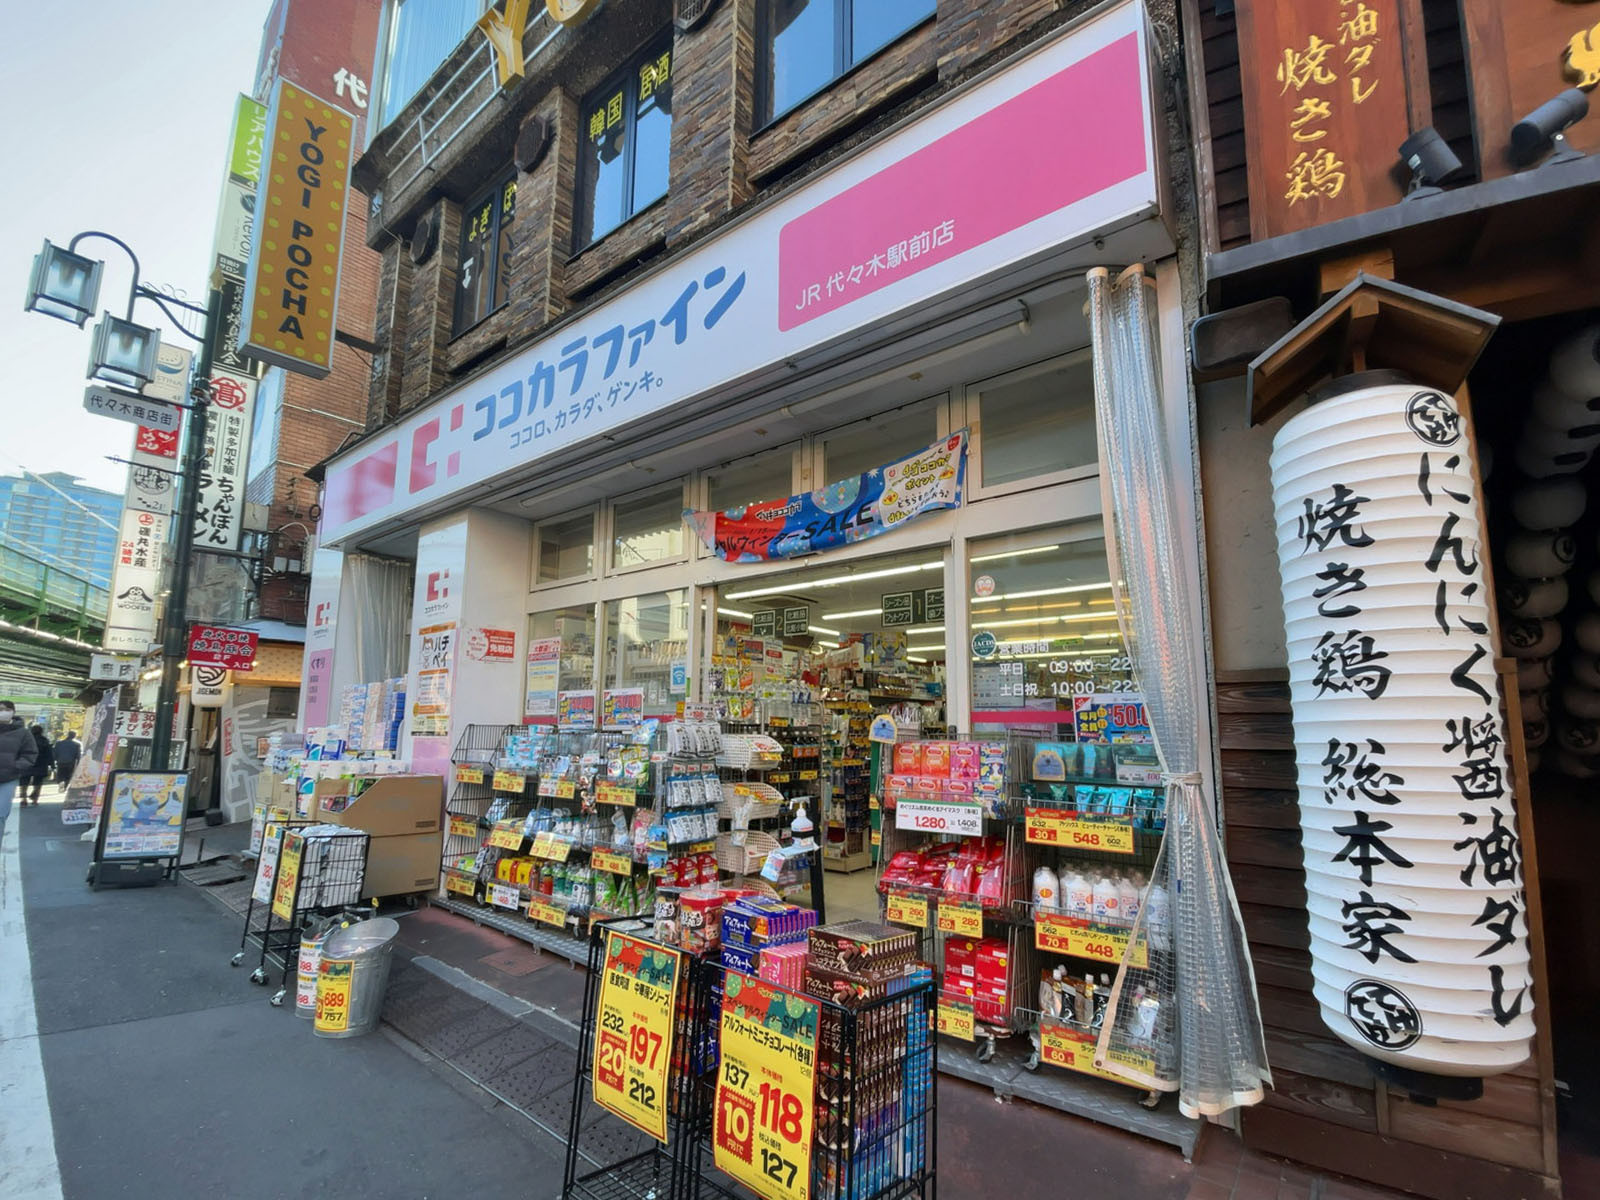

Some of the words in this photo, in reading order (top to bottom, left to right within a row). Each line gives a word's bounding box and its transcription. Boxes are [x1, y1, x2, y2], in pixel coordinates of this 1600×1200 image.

[1337, 0, 1381, 104] 油ダレ
[589, 91, 623, 140] 韓国
[1276, 34, 1346, 208] 焼き鶏
[297, 118, 326, 209] YOGI
[278, 219, 313, 340] POCHA
[795, 283, 821, 310] JR
[825, 219, 955, 297] 代々木駅前店
[473, 265, 746, 441] ココカラファイン
[90, 395, 172, 426] 代々木商店街
[510, 369, 664, 449] ココロ、カラダ、ゲンキ。
[209, 477, 235, 545] ちゃんぽん
[1297, 483, 1392, 700] 焼き鶏
[434, 635, 449, 652] ハチ
[999, 663, 1023, 676] 平日
[1000, 683, 1038, 697] 土日祝
[1417, 451, 1529, 1027] にんにく醤油ダレ
[1035, 830, 1048, 840] 30
[1073, 832, 1100, 846] 548
[1321, 737, 1419, 965] 総本家
[724, 915, 750, 931] アルフォート
[962, 917, 979, 927] 280
[811, 937, 838, 951] アルフォート
[1045, 937, 1059, 947] 70
[1085, 943, 1114, 958] 448
[324, 991, 345, 1007] 689
[324, 1012, 343, 1021] 757
[602, 1012, 624, 1034] 232
[953, 1018, 970, 1028] 703
[601, 1047, 624, 1076] 20
[630, 1024, 662, 1070] 197
[1051, 1051, 1065, 1061] 60
[724, 1062, 750, 1085] 137
[629, 1078, 655, 1109] 212
[723, 1102, 750, 1137] 10
[759, 1082, 803, 1144] 118
[761, 1148, 797, 1190] 127
